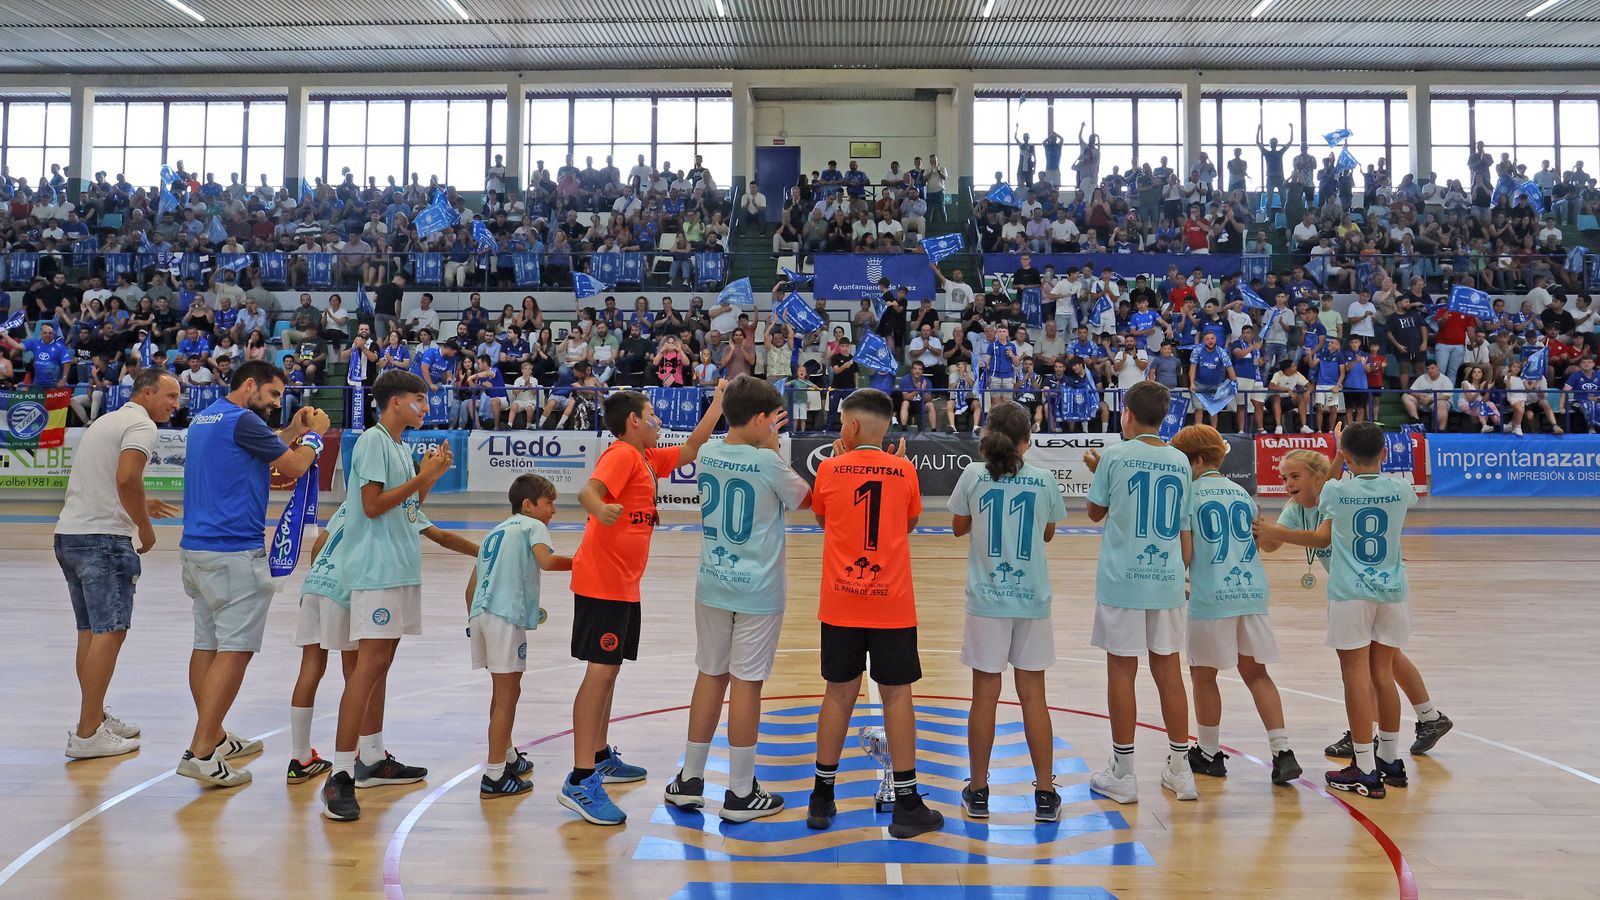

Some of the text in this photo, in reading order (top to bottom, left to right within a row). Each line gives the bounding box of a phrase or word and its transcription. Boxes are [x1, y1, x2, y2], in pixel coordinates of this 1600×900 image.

[833, 283, 881, 292] Ayuntamient
[353, 393, 362, 420] FUTSAL
[488, 435, 561, 457] Lledó
[1035, 439, 1104, 448] LEXUS
[489, 457, 533, 468] Gestión
[700, 456, 761, 473] XEREZFUTSAL
[1122, 459, 1187, 475] XEREZFUTSAL
[833, 465, 905, 478] XEREZFUTSAL
[1507, 471, 1565, 481] IMPRESIÓN
[1567, 472, 1576, 481] &
[0, 477, 64, 487] .albe1981.es
[977, 474, 1047, 488] XEZFUTSAL
[1127, 470, 1184, 541] 10
[1339, 494, 1402, 505] XEREZFUTSAL
[698, 472, 756, 545] 20
[854, 480, 883, 551] 1
[979, 488, 1037, 562] 11
[1197, 500, 1257, 565] 99
[1352, 506, 1389, 566] 8
[481, 529, 506, 580] 9
